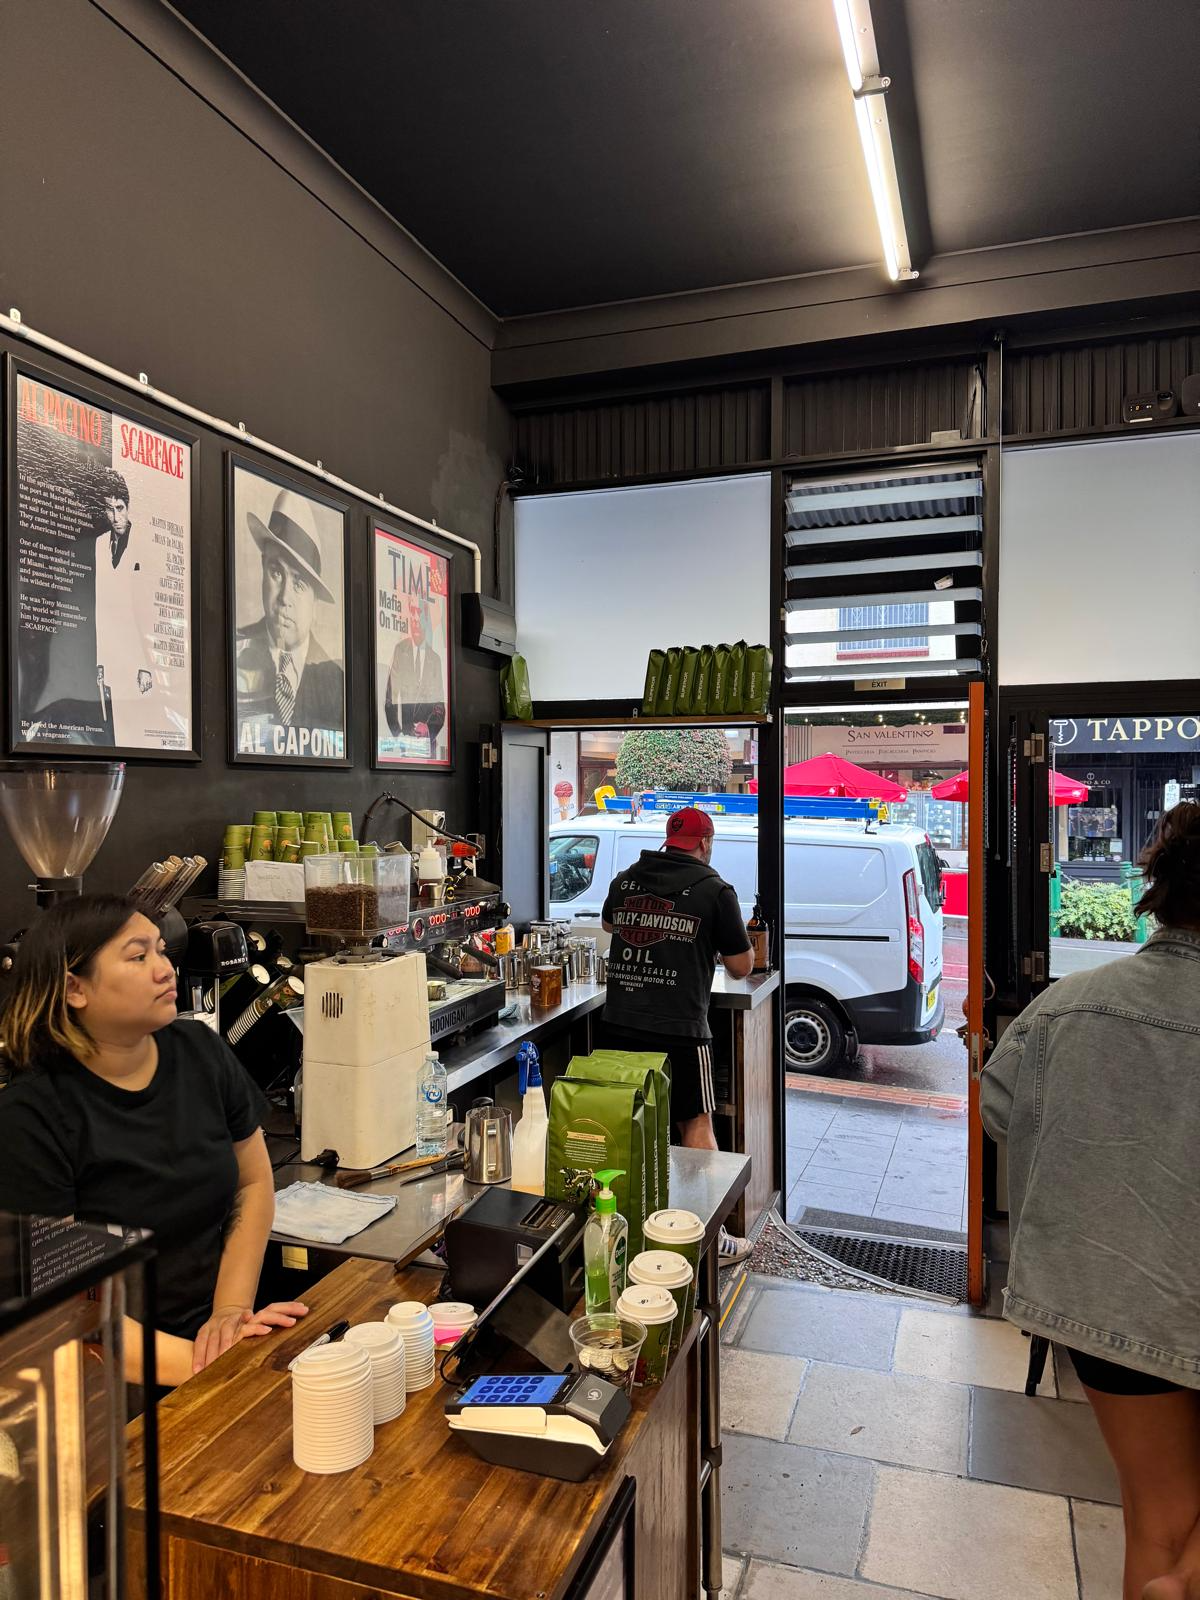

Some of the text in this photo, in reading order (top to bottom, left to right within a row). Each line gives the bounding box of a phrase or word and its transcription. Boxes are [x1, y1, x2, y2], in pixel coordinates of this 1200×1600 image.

[20, 381, 103, 448] AL PACINO
[120, 423, 184, 480] SCARFACE
[19, 483, 29, 491] the
[30, 487, 42, 496] port
[19, 494, 93, 520] was opened, and thousands
[19, 502, 28, 510] set
[40, 507, 49, 516] for
[50, 509, 58, 518] the
[59, 512, 77, 524] United
[78, 518, 95, 529] States.
[19, 511, 82, 534] They came in search of
[19, 520, 77, 541] the American Dream.
[19, 538, 32, 547] One
[40, 543, 54, 553] them
[54, 546, 70, 558] found
[19, 557, 26, 565] of
[69, 570, 86, 579] power
[28, 550, 38, 558] the
[71, 562, 92, 572] avenues
[19, 567, 74, 584] and passion beyond
[19, 575, 73, 593] his wildest dreams.
[388, 549, 436, 604] TIME
[20, 594, 28, 602] He
[42, 598, 56, 608] Tony
[56, 600, 81, 612] Montana.
[378, 589, 402, 613] Mafia
[20, 603, 32, 611] The
[32, 606, 50, 615] world
[60, 612, 88, 622] remember
[20, 612, 78, 629] him by another name
[378, 610, 409, 634] On Trial
[648, 676, 656, 702] SUPERIOR
[680, 671, 689, 699] SUPERIOR
[871, 680, 889, 689] EXIT
[20, 720, 30, 728] He
[48, 722, 58, 730] the
[58, 723, 85, 732] American
[42, 732, 73, 740] vengeance.
[848, 729, 871, 742] SAN
[1087, 718, 1200, 742] TAPPO
[240, 722, 266, 753] AL
[272, 724, 344, 760] CAPONE
[670, 934, 694, 944] MARK
[622, 948, 654, 964] OIL
[642, 966, 678, 978] SEALED
[642, 976, 664, 985] MOTOR
[666, 979, 678, 987] CO.
